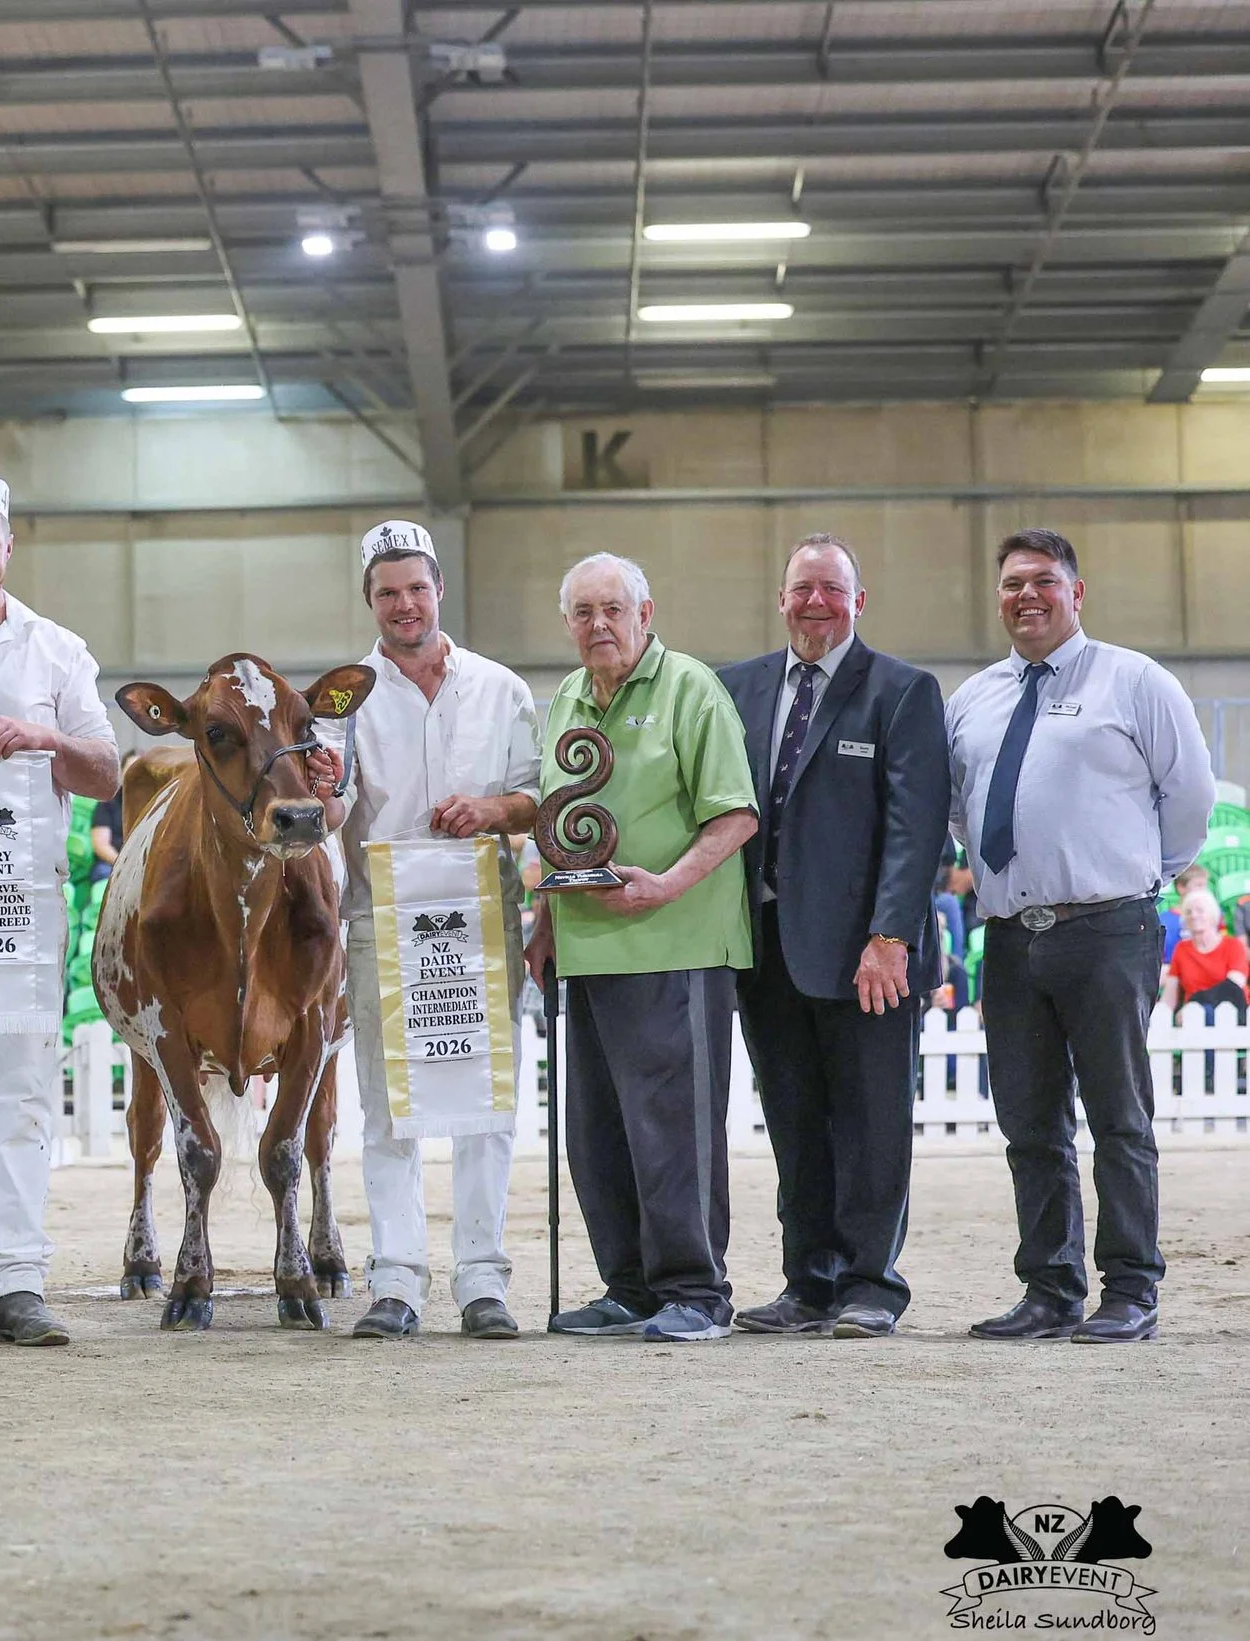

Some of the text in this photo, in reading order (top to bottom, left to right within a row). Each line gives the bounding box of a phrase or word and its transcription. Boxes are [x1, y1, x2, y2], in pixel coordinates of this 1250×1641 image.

[581, 430, 633, 489] K
[371, 534, 409, 554] SEMEX
[431, 942, 450, 953] NZ
[420, 953, 463, 967] DAIRY
[419, 966, 466, 979] EVENT
[411, 986, 477, 1002] CHAMPION
[412, 999, 478, 1015] INTERMEDIATE
[408, 1012, 484, 1029] INTERBREED
[425, 1038, 472, 1057] 2026
